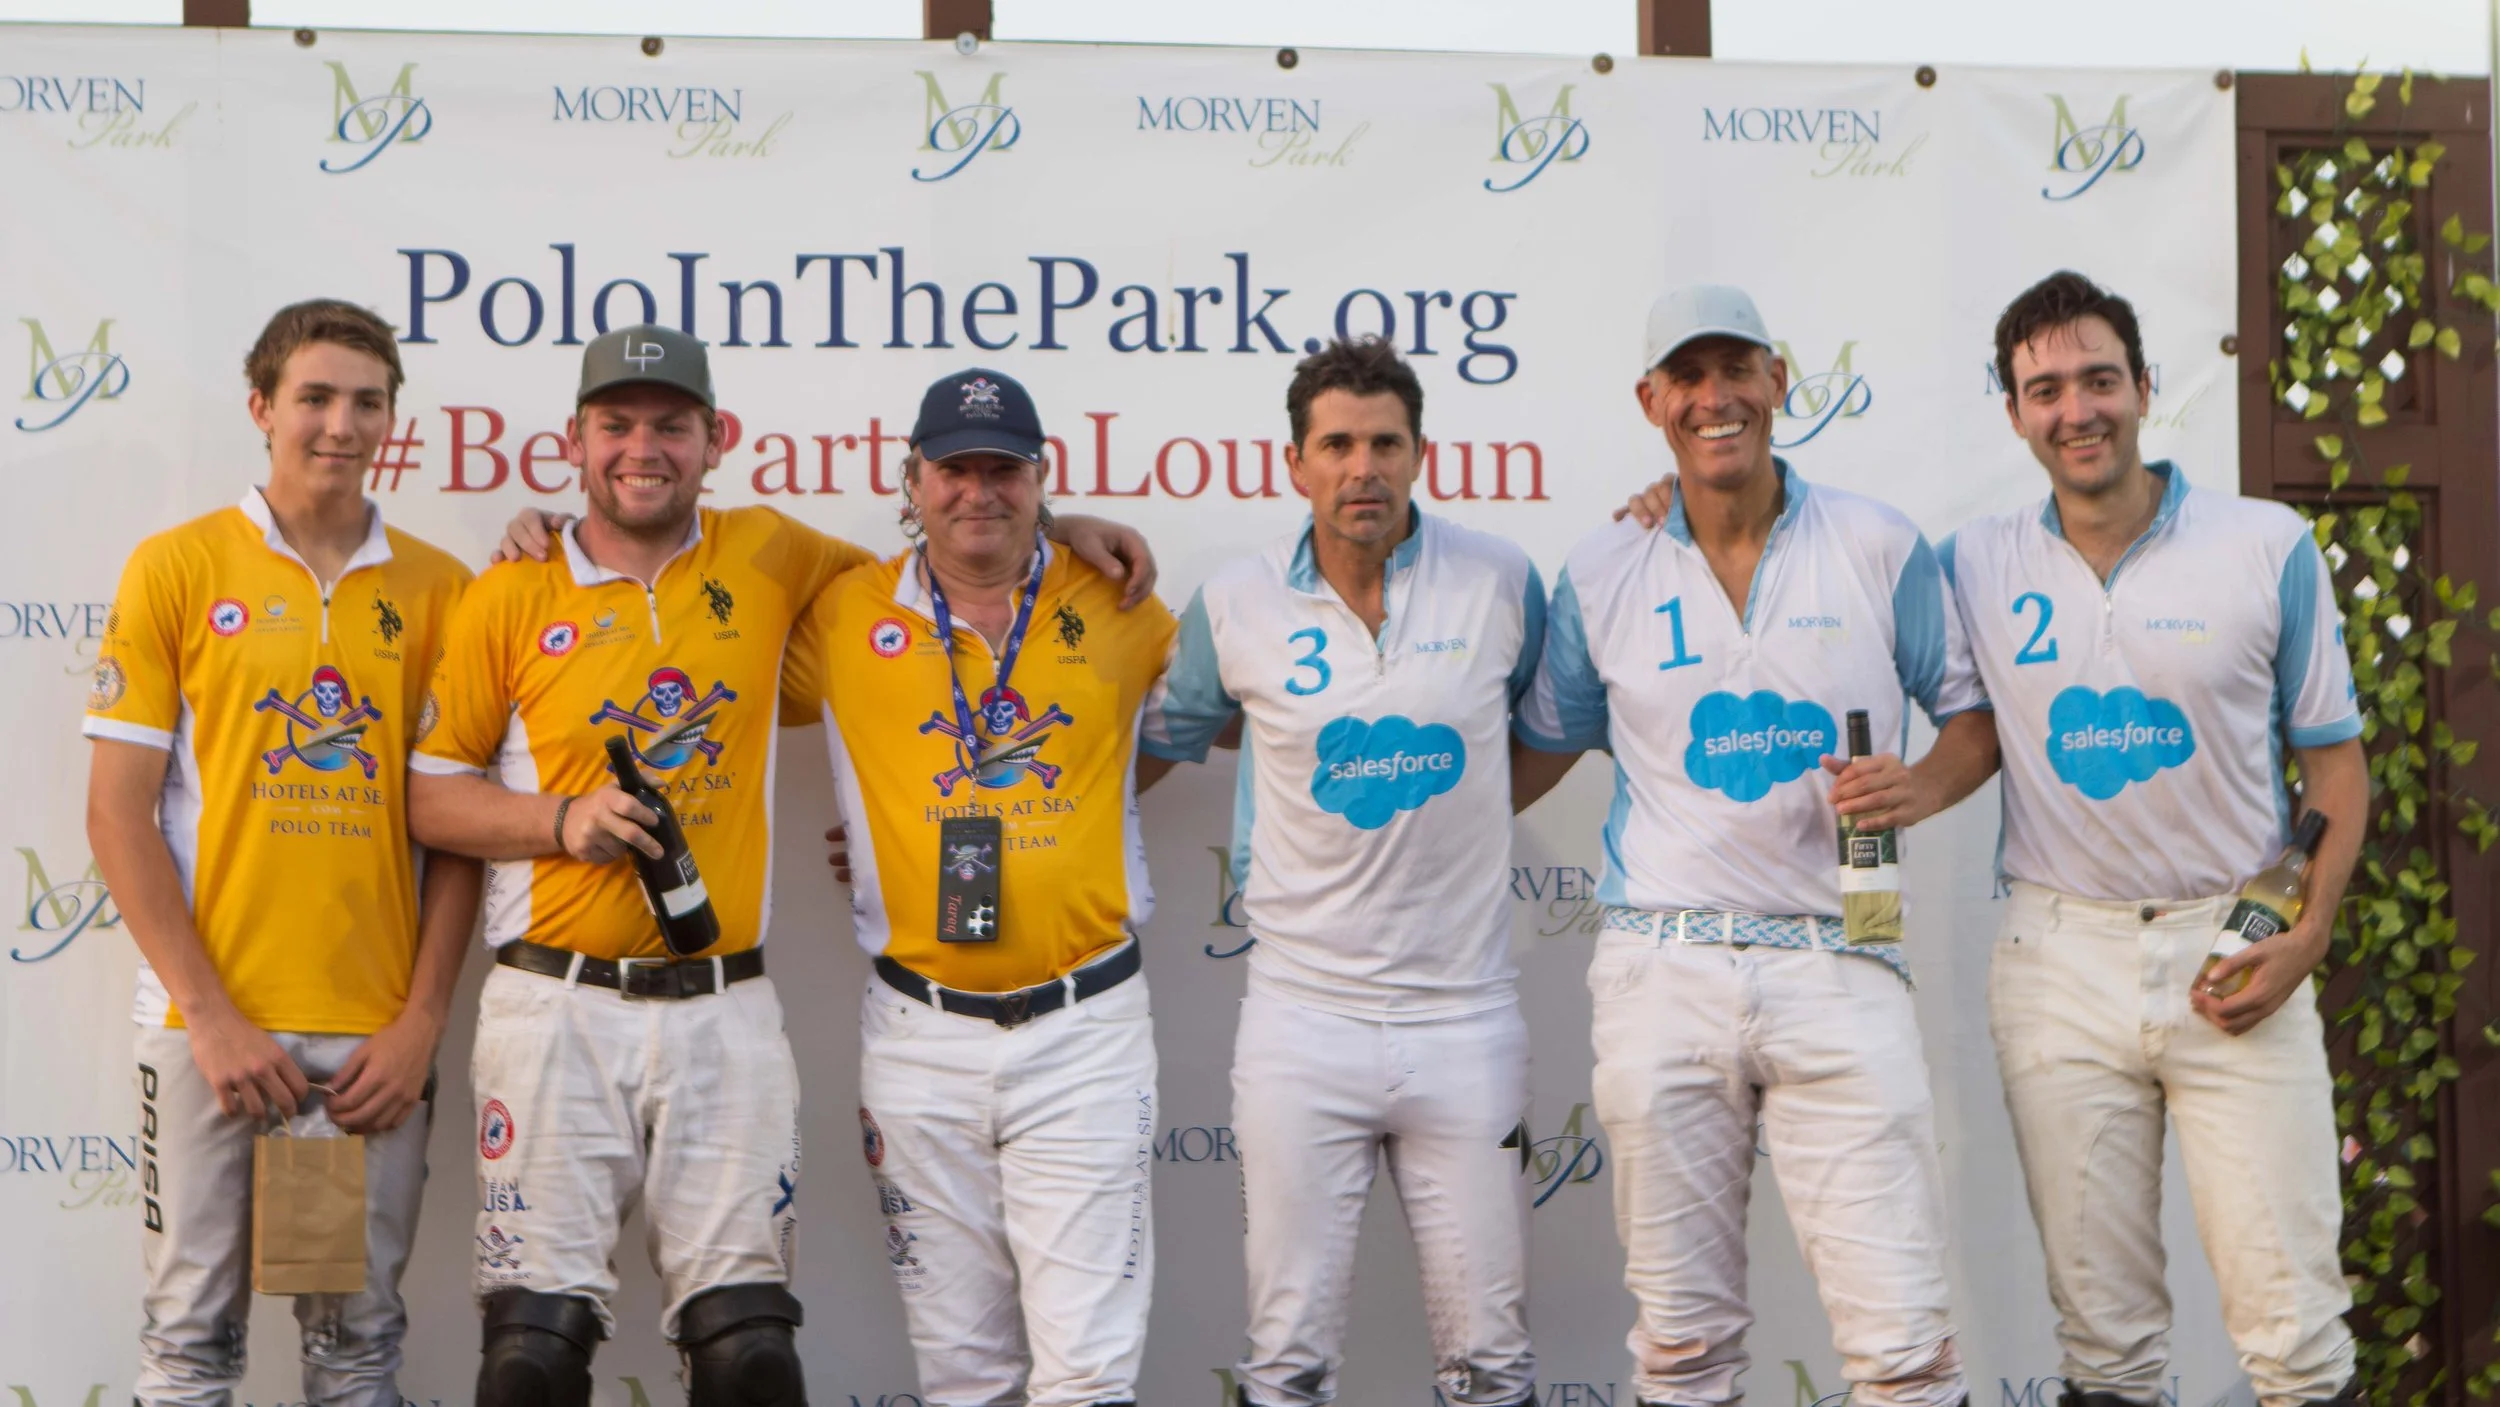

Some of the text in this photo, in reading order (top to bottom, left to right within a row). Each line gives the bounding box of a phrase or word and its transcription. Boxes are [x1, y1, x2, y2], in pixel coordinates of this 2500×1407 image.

[0, 76, 145, 113] ORVEN
[553, 86, 742, 124] MORVEN
[67, 101, 198, 150] Park
[1137, 96, 1320, 132] MORVEN
[1703, 107, 1880, 144] MORVEN
[666, 111, 793, 158] Park
[1248, 121, 1371, 168] Park
[1811, 133, 1929, 178] Park
[396, 242, 1518, 385] PoloInThePark.org
[0, 602, 113, 638] ORVE
[713, 629, 741, 641] USPA
[1654, 596, 1703, 671] 1
[1787, 616, 1841, 628] MORVEN
[2012, 591, 2058, 666] 2
[374, 648, 401, 661] USPA
[1057, 654, 1087, 665] USPA
[1284, 626, 1332, 696] 3
[1415, 638, 1466, 653] MORVEN
[1704, 725, 1824, 755] salesforce
[2061, 721, 2184, 752] salesforce
[1329, 750, 1453, 782] salesforce
[251, 782, 386, 805] HOTELS AT SE
[1010, 799, 1036, 816] AT
[1042, 796, 1076, 813] SEA
[270, 819, 372, 838] POLO TEAM
[676, 811, 713, 826] EAM
[1004, 835, 1058, 851] TEAM
[1510, 866, 1596, 900] RVEN
[1538, 892, 1602, 937] Pa
[0, 1136, 138, 1172] RVEN
[138, 1062, 164, 1235] PRISA
[59, 1162, 139, 1210] Par
